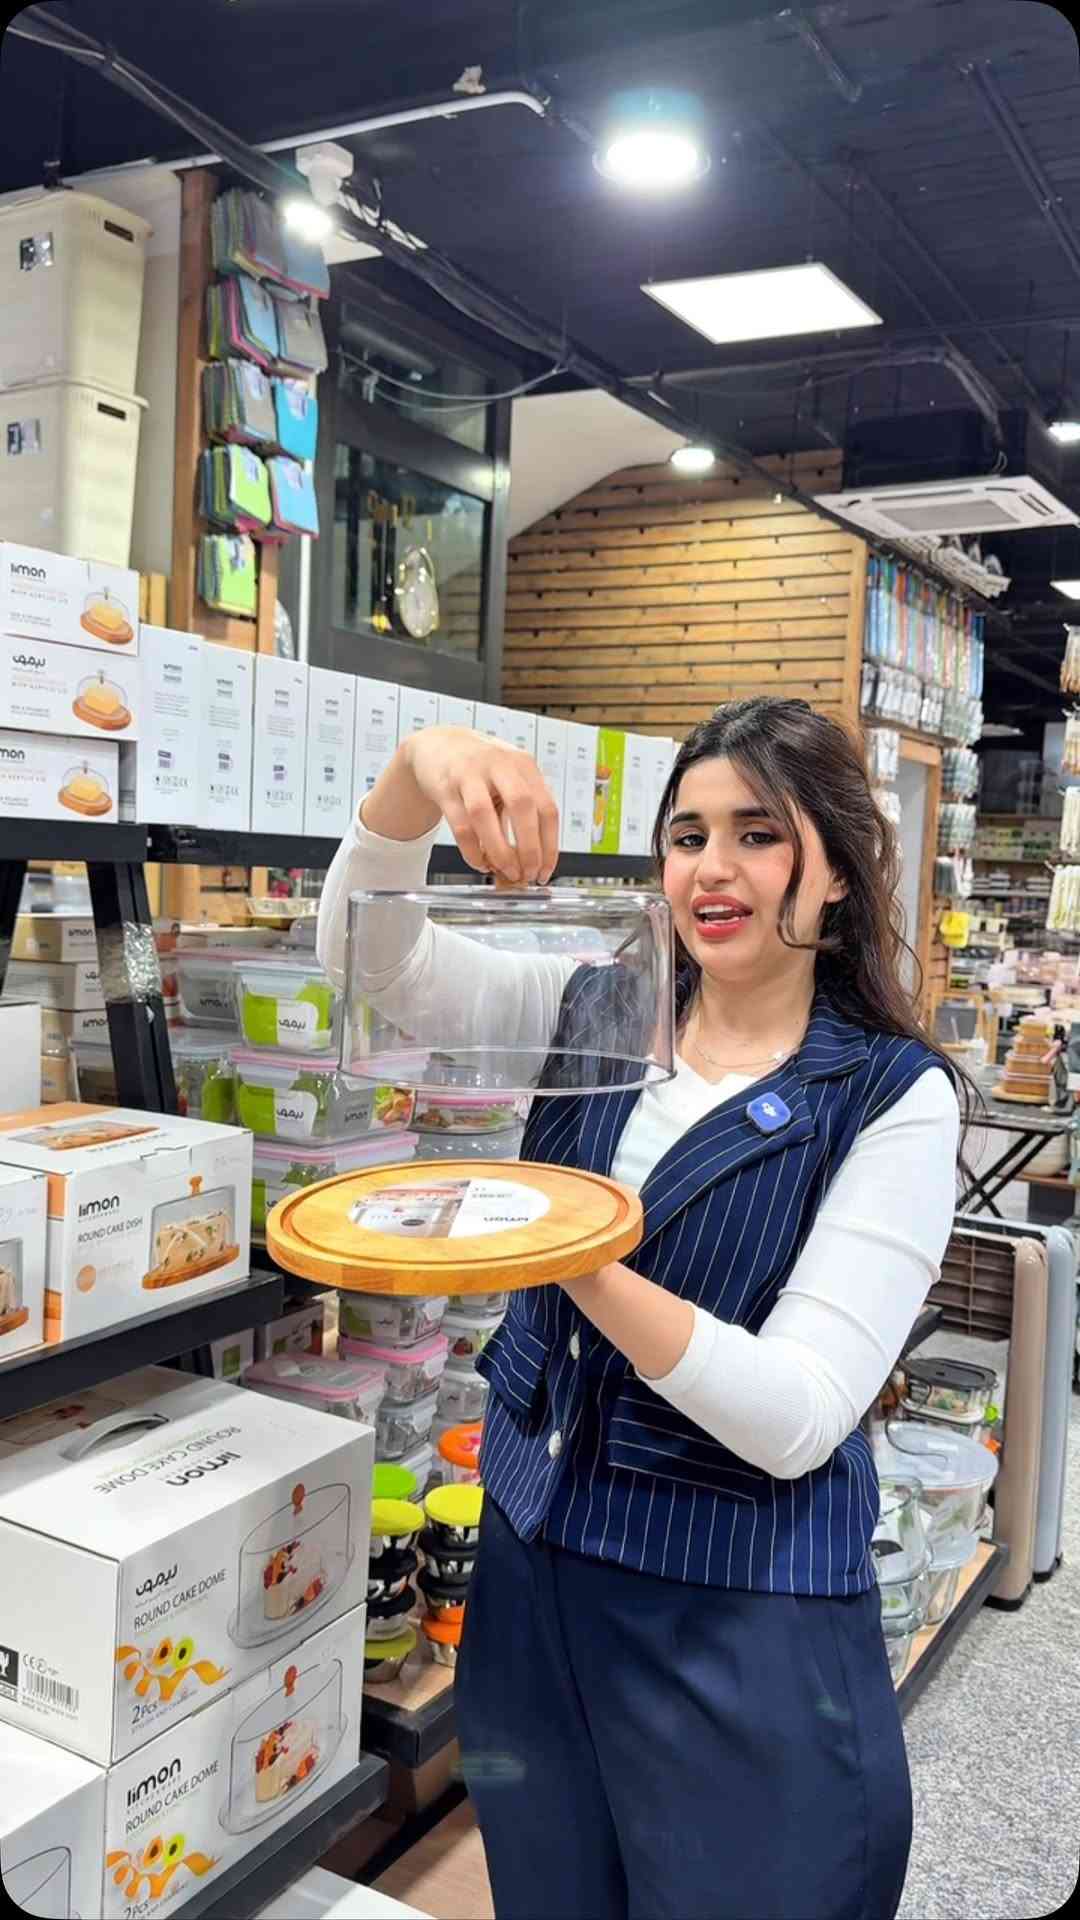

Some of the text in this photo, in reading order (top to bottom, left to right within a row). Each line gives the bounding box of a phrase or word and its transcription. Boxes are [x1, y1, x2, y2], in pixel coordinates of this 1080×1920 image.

[10, 562, 46, 579] limon
[12, 654, 46, 669] ليمون
[278, 1018, 306, 1031] ليمون
[276, 1106, 304, 1120] ليمون
[78, 1195, 120, 1217] limon
[78, 1227, 106, 1243] ROUND
[106, 1221, 125, 1236] CAKE
[94, 1425, 242, 1495] ROUND CAKE DOME
[165, 1450, 242, 1487] limon
[135, 1562, 178, 1597] ليمون
[134, 1567, 227, 1631] ROUND CAKE DOME
[126, 1757, 181, 1807] limon
[125, 1759, 219, 1835] ROUND CAKE DOME
